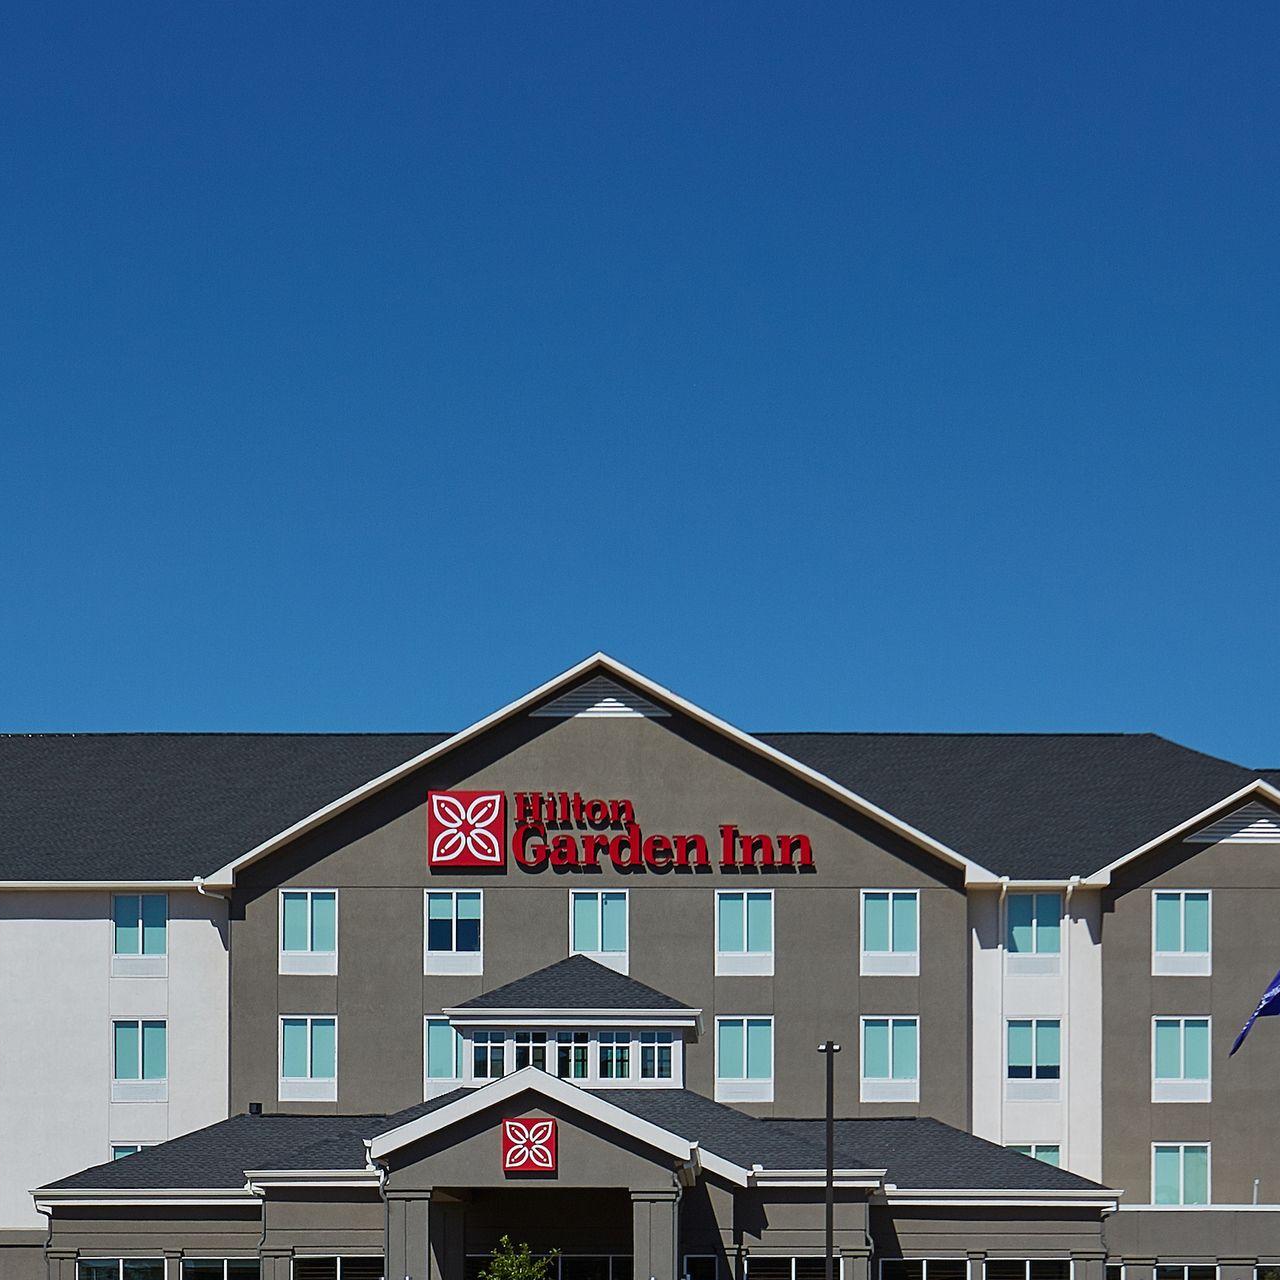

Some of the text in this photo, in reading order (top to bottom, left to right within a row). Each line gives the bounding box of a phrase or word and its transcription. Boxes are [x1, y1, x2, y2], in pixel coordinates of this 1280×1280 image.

[513, 791, 635, 821] Hilton
[512, 823, 815, 865] Garden Inn
